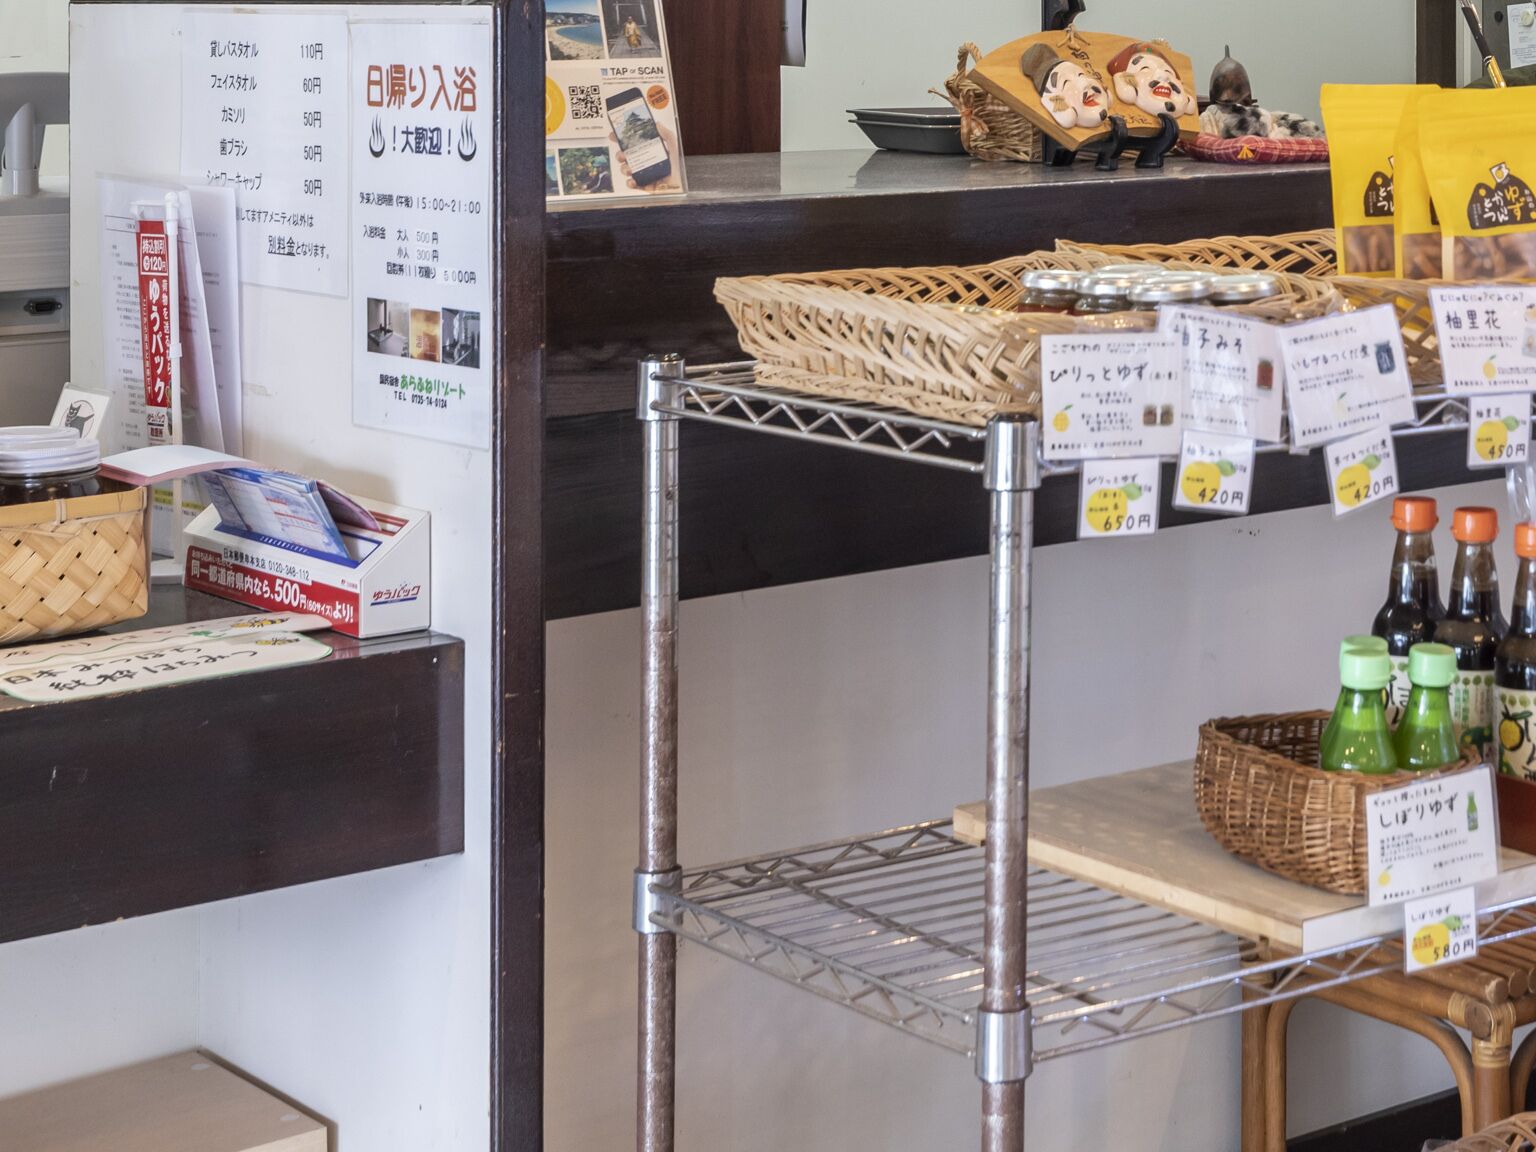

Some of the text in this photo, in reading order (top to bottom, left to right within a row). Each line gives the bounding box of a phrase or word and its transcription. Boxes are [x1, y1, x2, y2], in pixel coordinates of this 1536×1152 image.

[210, 40, 323, 60] 貸しバスタオル 110円
[610, 68, 628, 76] TAP
[638, 67, 664, 75] SCAN
[211, 74, 321, 94] フェイスタオル 60円
[367, 64, 477, 112] 日帰り入浴
[221, 106, 321, 128] カミソリ 50円
[219, 138, 322, 162] 歯ブラシ 50円
[304, 180, 322, 196] 50円
[1504, 186, 1525, 221] ゆず
[363, 224, 439, 245] 入浴料金 大人 500円
[268, 235, 330, 259] 別料金となります。
[397, 247, 439, 262] 小人 300円
[1445, 309, 1501, 329] 柚里花
[148, 279, 166, 404] ゆうパック
[394, 391, 407, 401] TEL
[400, 374, 466, 399] あらふねリゾート
[1488, 445, 1526, 459] 450円
[1198, 487, 1244, 505] 420円
[1354, 476, 1394, 503] 420円
[1103, 514, 1151, 532] 650円
[372, 583, 421, 601] ゆうパック
[1380, 792, 1458, 828] しぼりゆず
[1434, 938, 1474, 962] 580円
